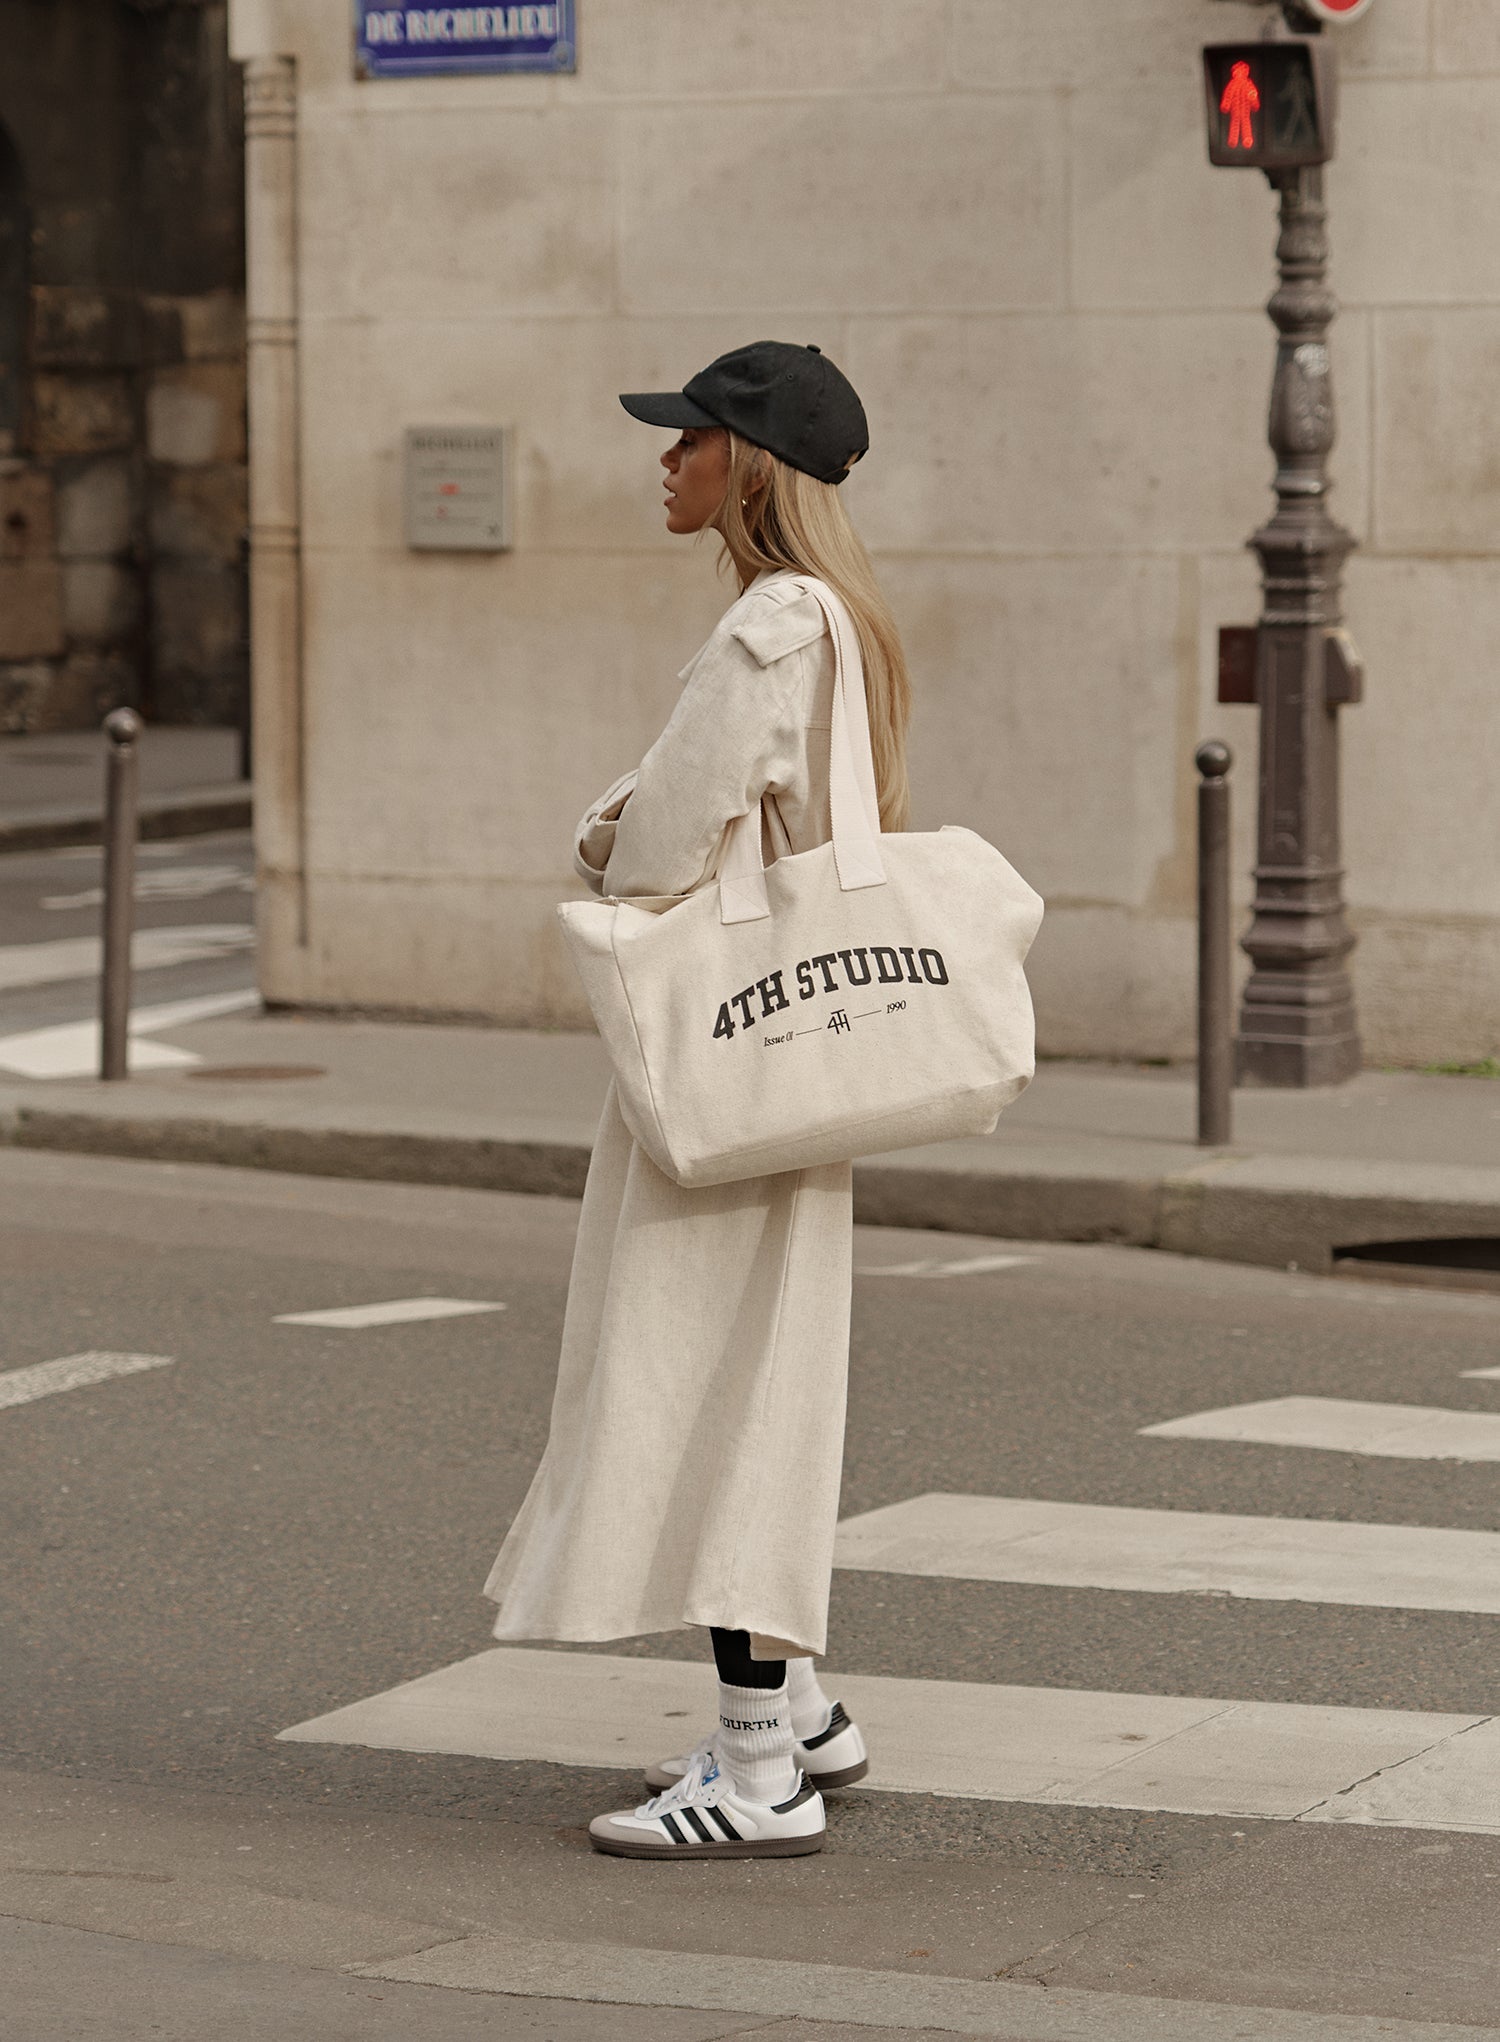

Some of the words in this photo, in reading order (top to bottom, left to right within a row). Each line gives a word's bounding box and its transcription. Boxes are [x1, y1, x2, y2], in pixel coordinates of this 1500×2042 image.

[366, 11, 402, 43] DE
[406, 6, 556, 43] RICHELIEU
[712, 970, 790, 1039] 4TH
[796, 947, 949, 1000] STUDIO
[764, 1036, 785, 1047] Issue
[886, 1000, 907, 1014] 1990
